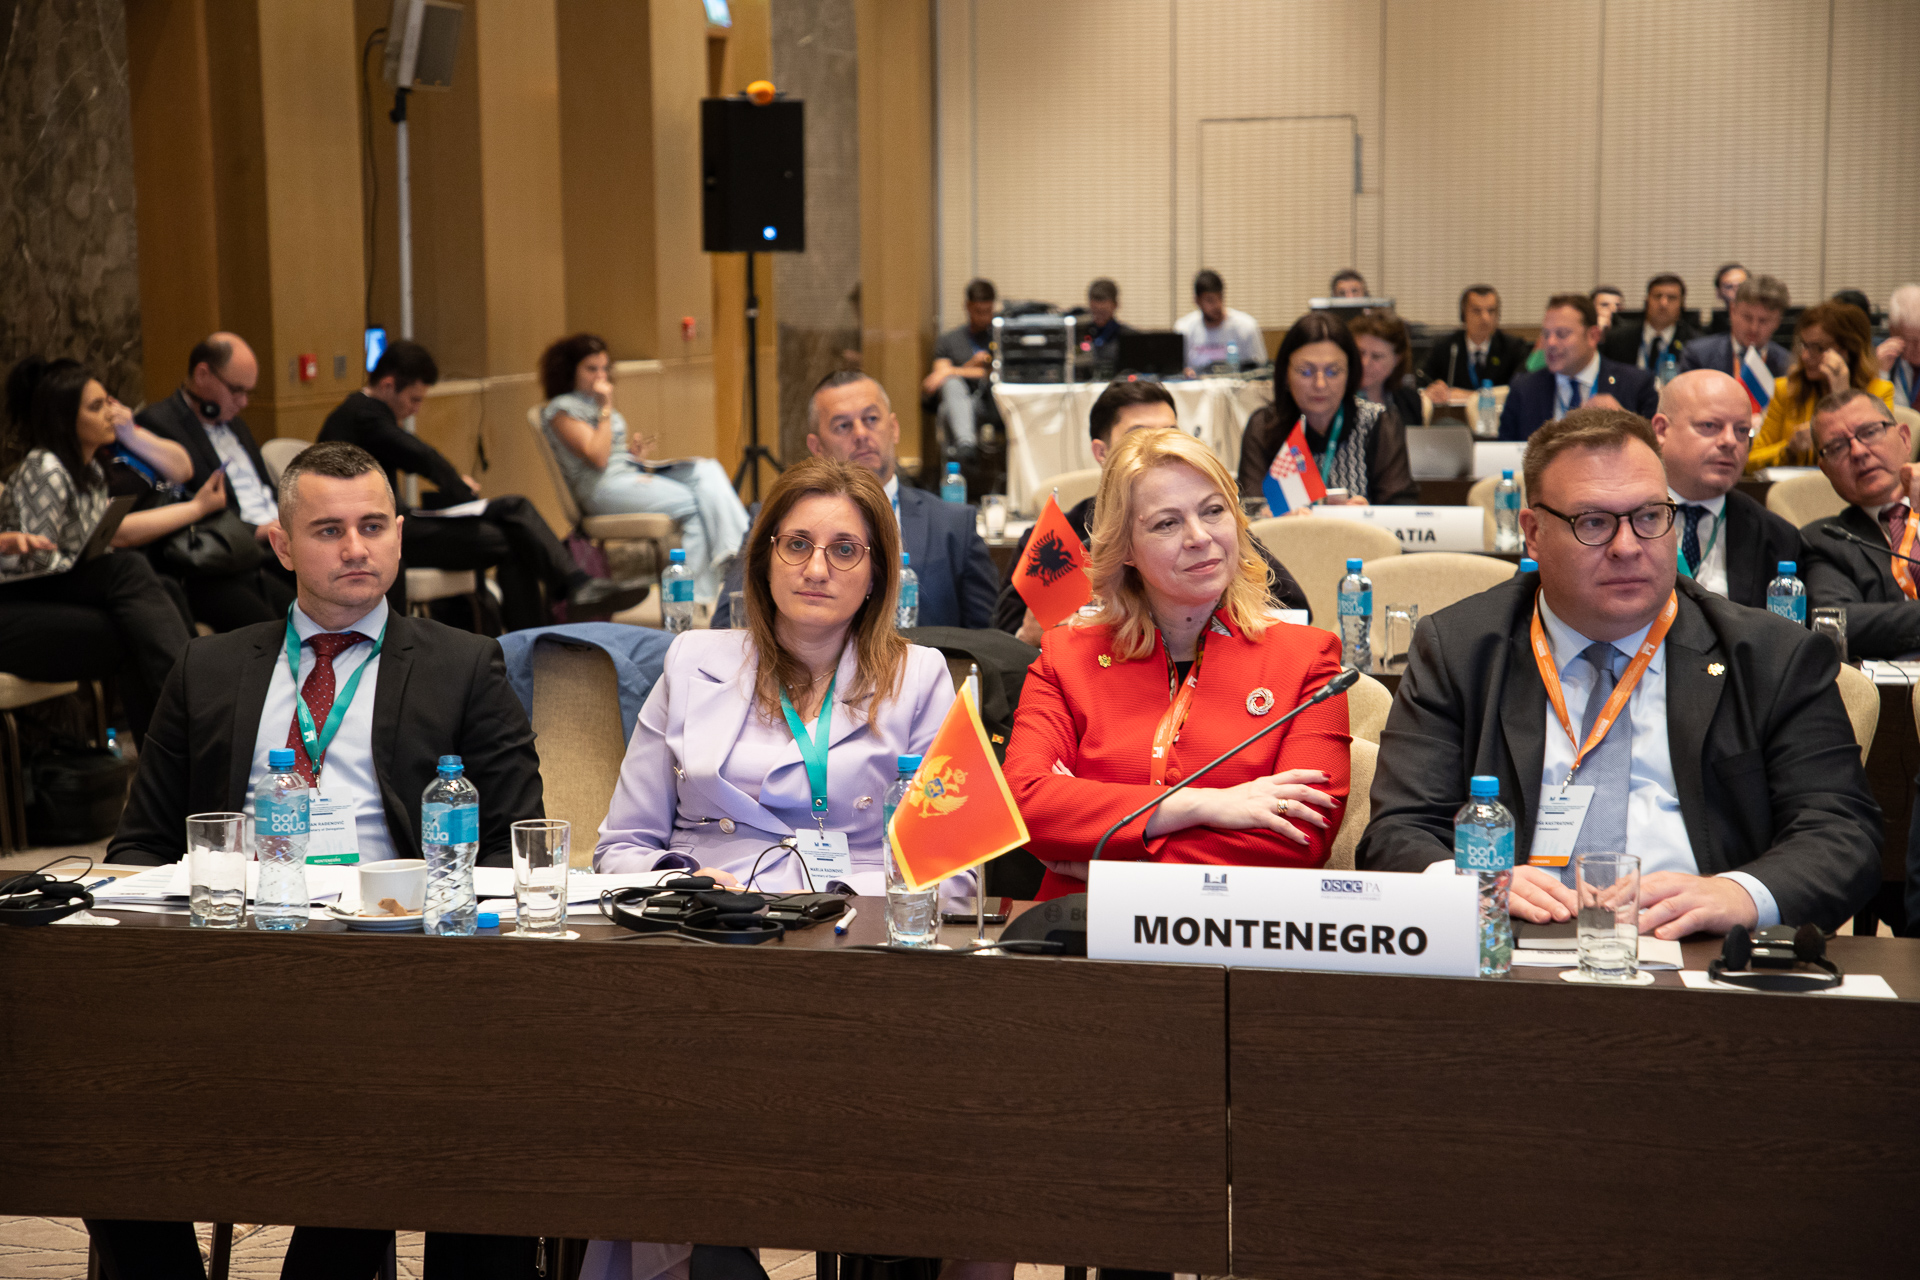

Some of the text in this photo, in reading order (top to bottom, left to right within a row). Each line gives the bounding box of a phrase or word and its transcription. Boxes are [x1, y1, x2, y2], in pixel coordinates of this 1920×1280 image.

[1395, 527, 1437, 542] ATIA
[271, 812, 299, 823] bon
[271, 822, 306, 833] aqua
[1467, 844, 1497, 856] bon
[1467, 855, 1506, 868] aqua
[1365, 882, 1381, 893] PA
[1133, 915, 1428, 956] MONTENEGRO
